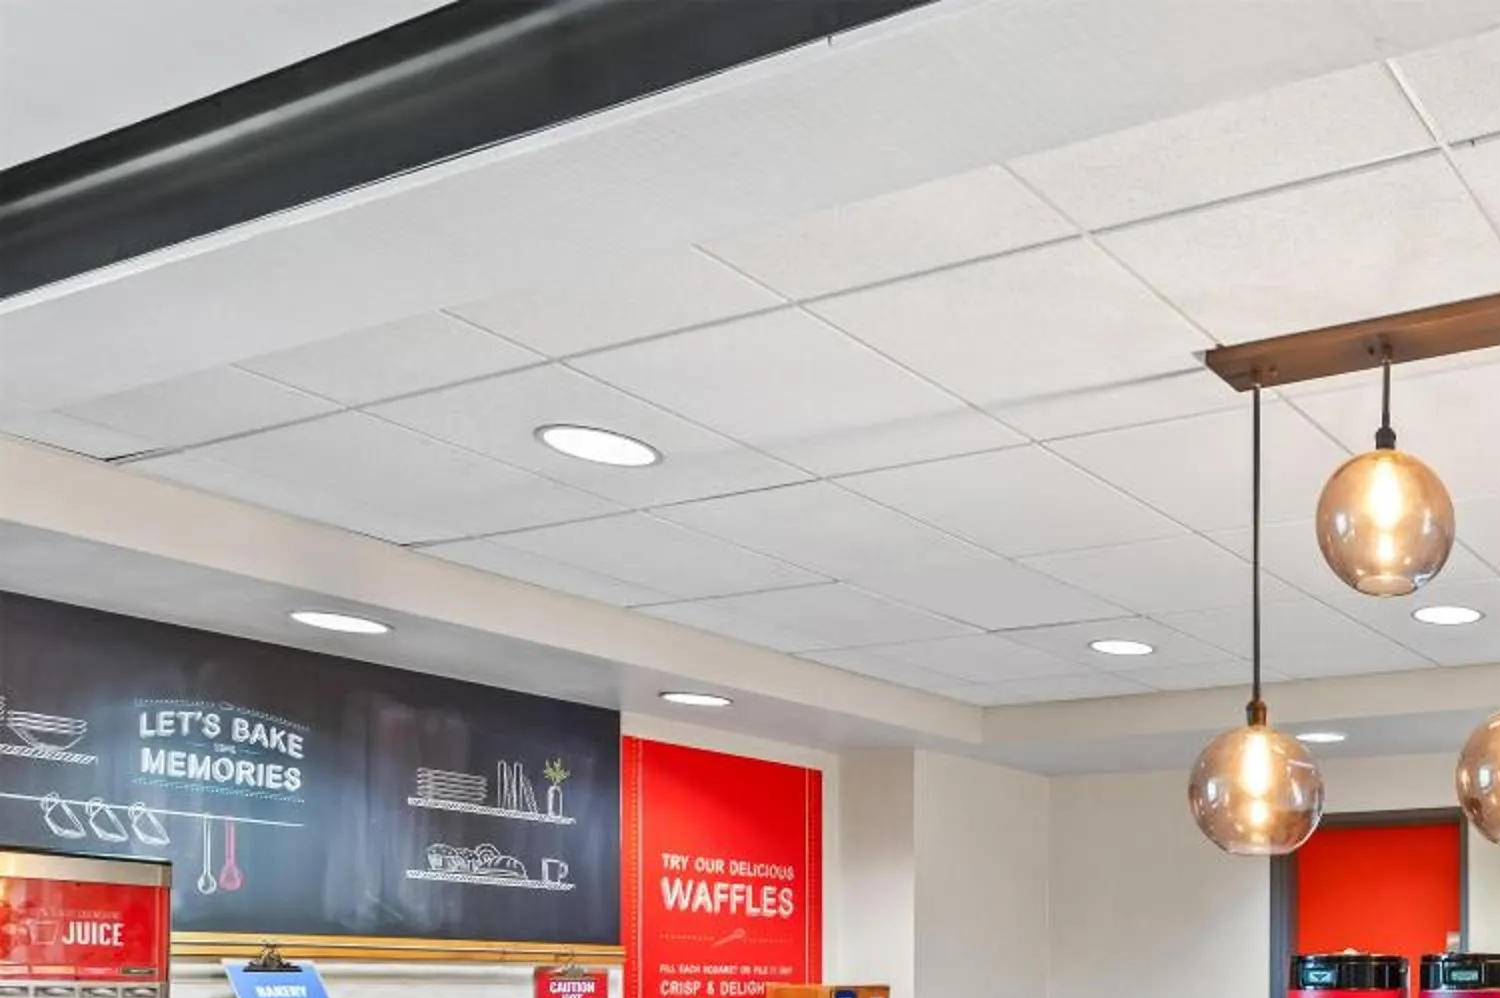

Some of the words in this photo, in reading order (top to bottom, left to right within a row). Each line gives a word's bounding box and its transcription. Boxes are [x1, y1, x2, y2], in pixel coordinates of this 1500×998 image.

[139, 710, 221, 739] LET'S
[231, 717, 304, 759] BAKE
[140, 747, 301, 792] MEMORIES
[661, 853, 689, 872] TRY
[694, 856, 725, 874] OUR
[729, 859, 794, 881] DELICIOUS
[660, 876, 794, 919] WAFFLES
[62, 920, 125, 947] JUICE
[255, 984, 307, 998] BAKERY
[549, 981, 596, 994] CAUTION
[660, 980, 700, 996] CRISP
[706, 980, 715, 996] &
[719, 980, 766, 996] DELIGH
